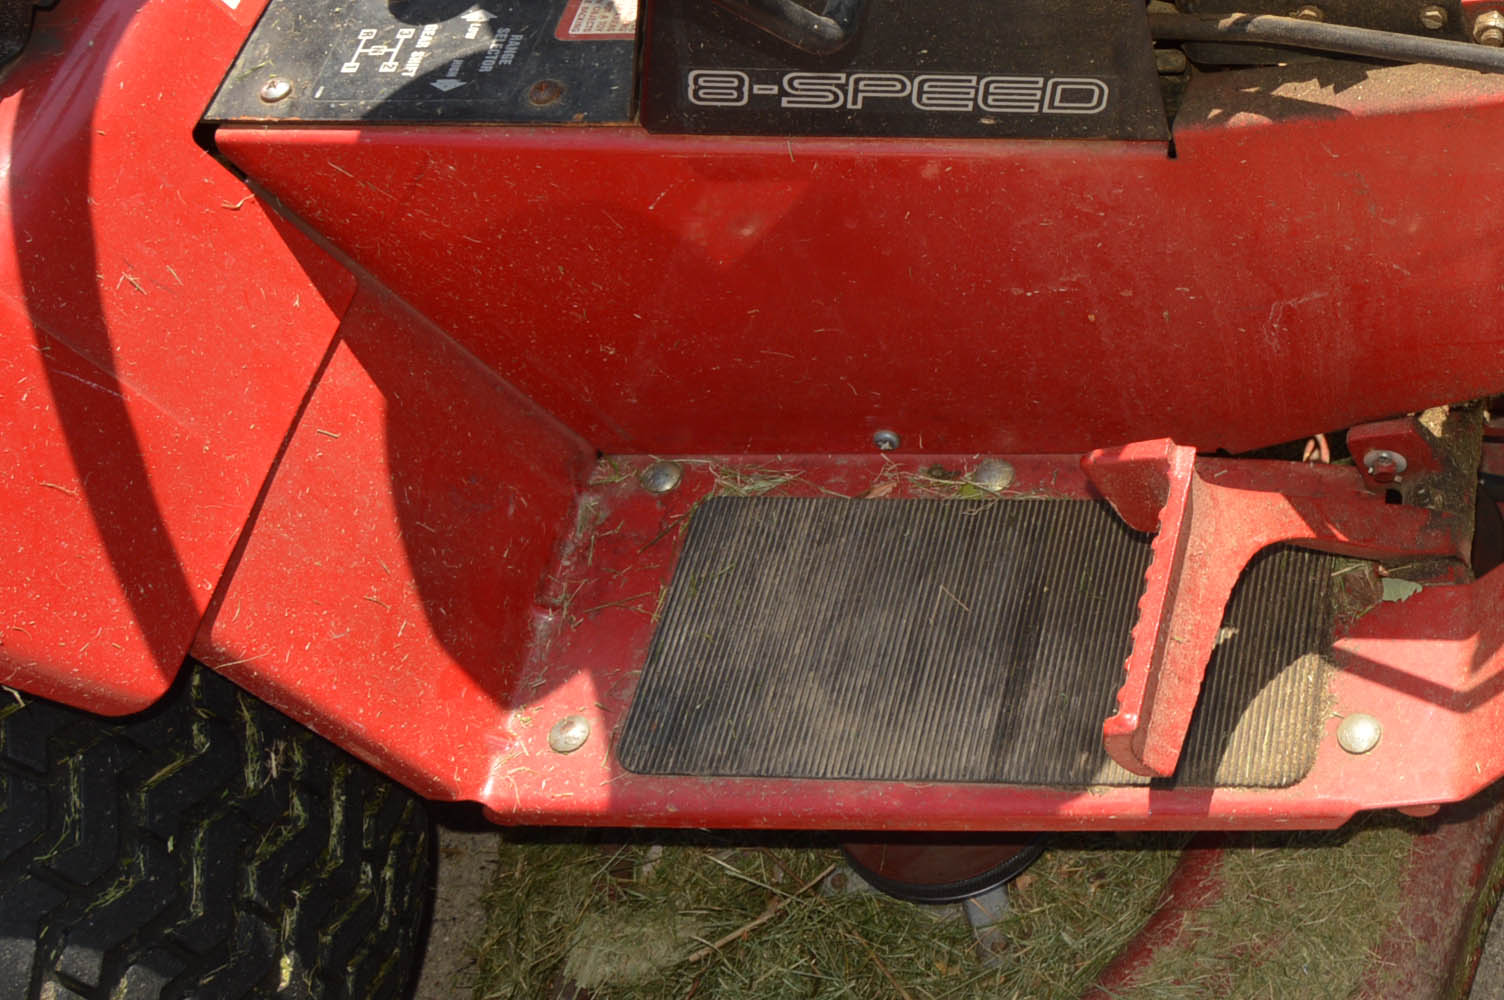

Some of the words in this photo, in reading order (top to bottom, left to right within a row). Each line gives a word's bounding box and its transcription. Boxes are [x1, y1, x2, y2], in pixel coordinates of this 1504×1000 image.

[414, 23, 440, 48] GEAR
[463, 23, 482, 39] LOW
[399, 50, 426, 77] SHIFT
[477, 27, 511, 72] SELECTOR
[497, 34, 524, 65] RANGE
[688, 70, 1109, 114] 8-SPEED
